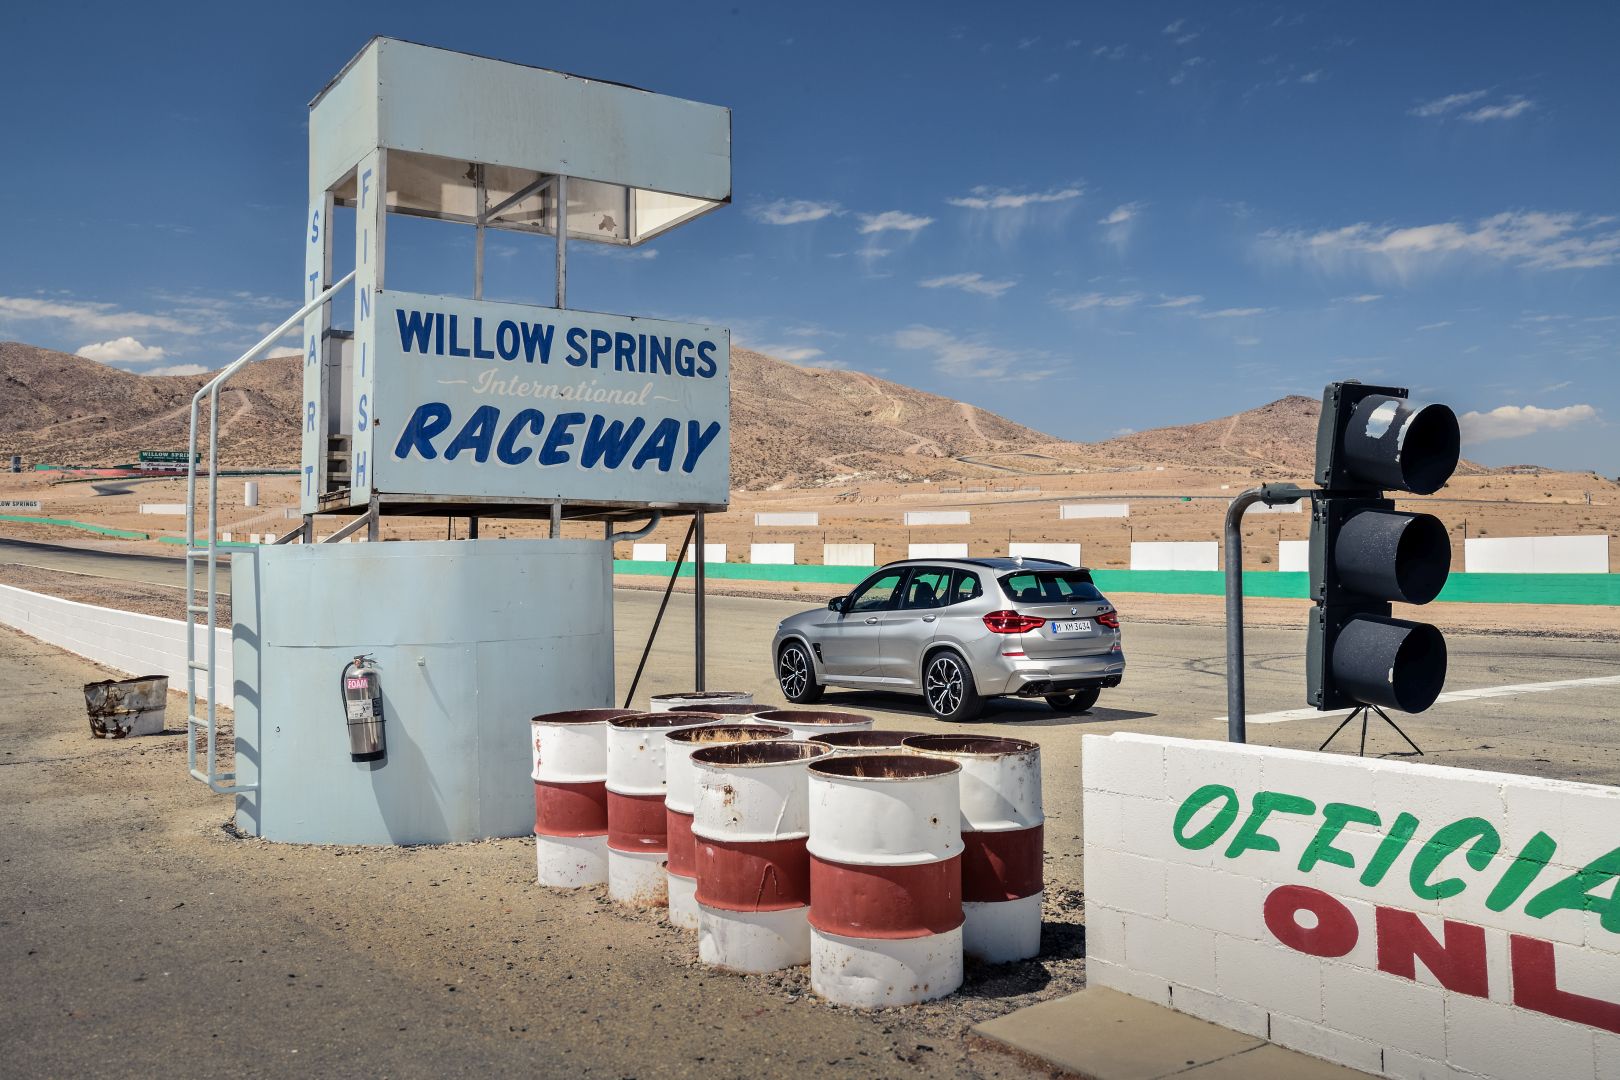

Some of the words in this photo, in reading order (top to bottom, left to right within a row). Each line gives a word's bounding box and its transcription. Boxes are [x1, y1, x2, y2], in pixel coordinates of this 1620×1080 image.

[304, 210, 320, 497] START
[356, 168, 372, 488] FINISH
[395, 308, 555, 365] WILLOW
[565, 326, 718, 379] SPRINGS
[472, 367, 654, 406] International
[393, 401, 722, 475] RACEWAY
[1056, 623, 1062, 631] M
[1074, 621, 1090, 631] 3434
[348, 679, 368, 689] FOAM
[1172, 783, 1620, 935] OFFICIA
[1263, 884, 1620, 1034] ONL
